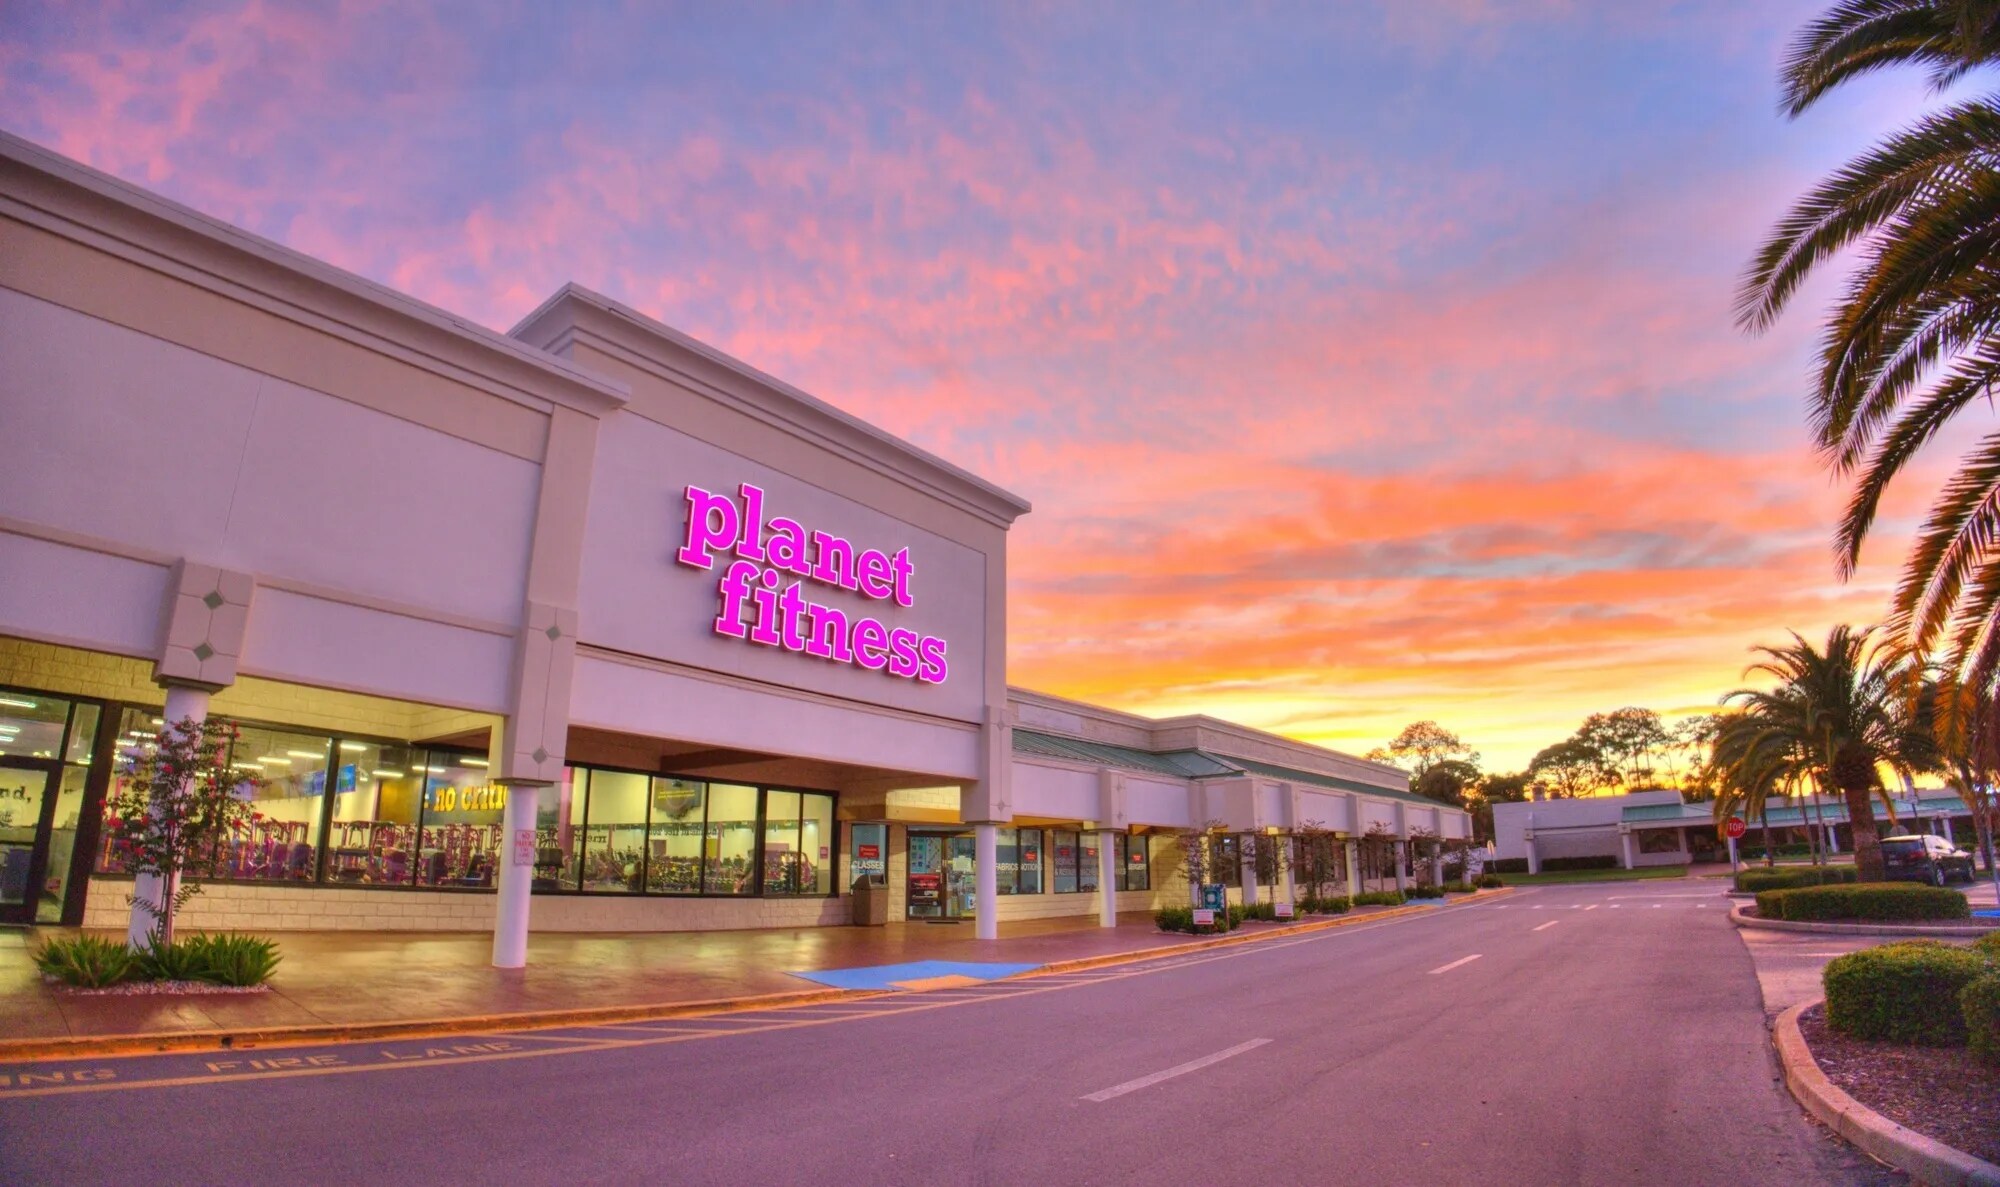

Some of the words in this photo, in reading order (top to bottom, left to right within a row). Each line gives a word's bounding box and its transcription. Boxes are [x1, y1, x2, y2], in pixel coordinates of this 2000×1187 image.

[678, 482, 914, 607] planet
[714, 560, 948, 685] fitness
[433, 786, 456, 812] no
[851, 860, 885, 870] CLASSES
[205, 1054, 350, 1073] FIRE
[382, 1041, 523, 1060] LANE
